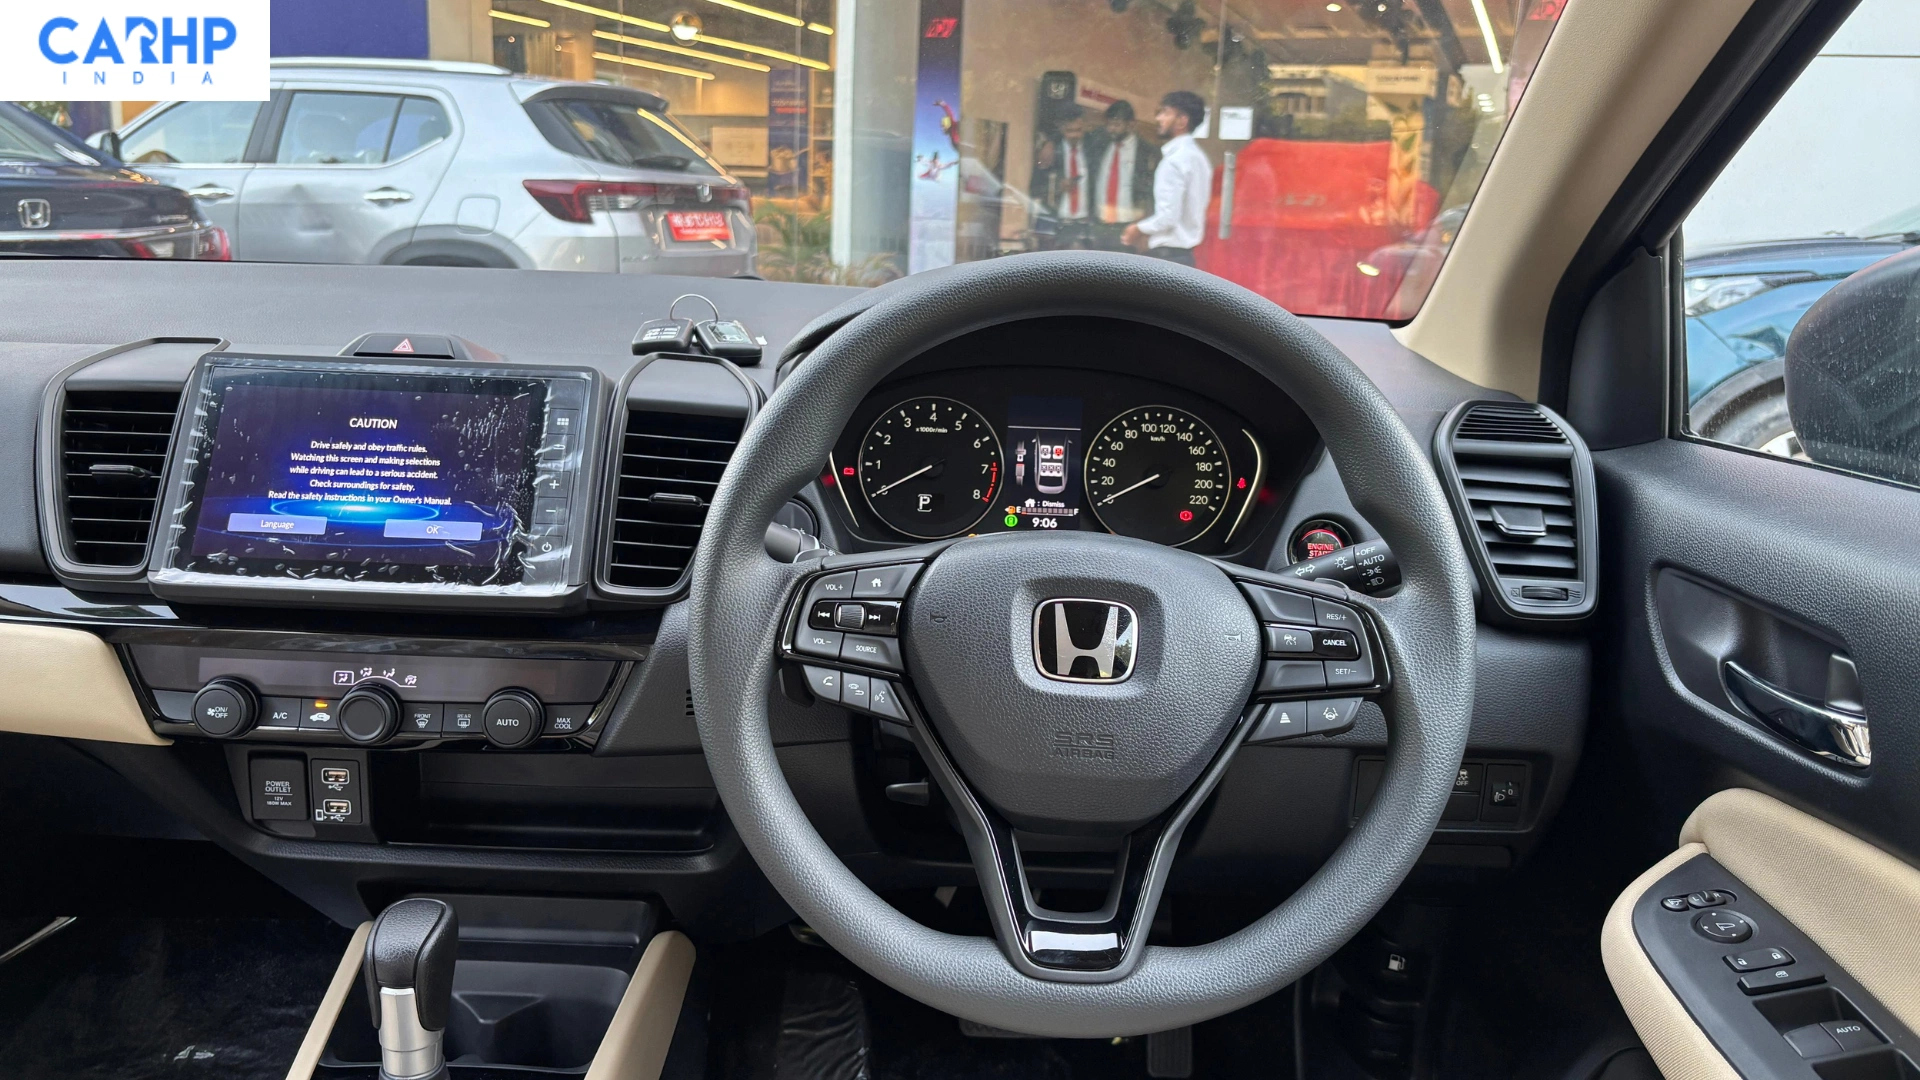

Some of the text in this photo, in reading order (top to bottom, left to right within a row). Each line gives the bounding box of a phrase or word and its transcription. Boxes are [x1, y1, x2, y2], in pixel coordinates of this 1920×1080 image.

[929, 412, 937, 422] 4
[349, 417, 398, 429] CAUTION
[903, 417, 912, 428] 3
[955, 420, 962, 431] 5
[1141, 423, 1157, 433] 100
[1159, 424, 1176, 434] 120
[1124, 429, 1138, 439] 80
[1176, 432, 1193, 442] 140
[883, 434, 891, 445] 2
[973, 439, 981, 449] 6
[310, 440, 428, 453] Drive safely and obey traffic rules.
[1110, 441, 1124, 451] 60
[1188, 446, 1206, 455] 160
[290, 452, 441, 467] Watching this screen and making selections
[1102, 458, 1116, 467] 40
[876, 460, 881, 470] 1
[981, 464, 989, 474] 7
[1195, 462, 1213, 472] 180
[289, 466, 309, 474] while
[310, 467, 335, 477] driving
[335, 468, 349, 476] can
[349, 468, 365, 476] lead
[365, 469, 374, 477] to
[380, 469, 405, 478] serious
[406, 469, 438, 479] accident.
[309, 479, 415, 493] Check surroundings for safety.
[1101, 476, 1115, 486] 20
[1194, 480, 1213, 489] 200
[268, 491, 452, 506] Read the safety instructions in your Owner's Manual.
[972, 489, 981, 500] 8
[919, 495, 931, 510] P
[1042, 500, 1065, 508] Dismiss
[1189, 495, 1208, 505] 220
[260, 519, 295, 529] Language
[1032, 517, 1058, 528] 9:06
[426, 525, 440, 534] OK
[1307, 543, 1334, 551] ENGINE
[1360, 546, 1376, 556] OFF
[1363, 554, 1385, 566] AUTO
[1326, 613, 1347, 621] RES/+
[1322, 638, 1347, 647] CANCEL
[855, 645, 877, 654] SOURCE
[272, 711, 288, 720] A/C
[496, 718, 520, 727] AUTO
[1054, 747, 1115, 760] AIRBAG
[1507, 788, 1514, 796] 0
[1835, 1024, 1861, 1034] AUTO
